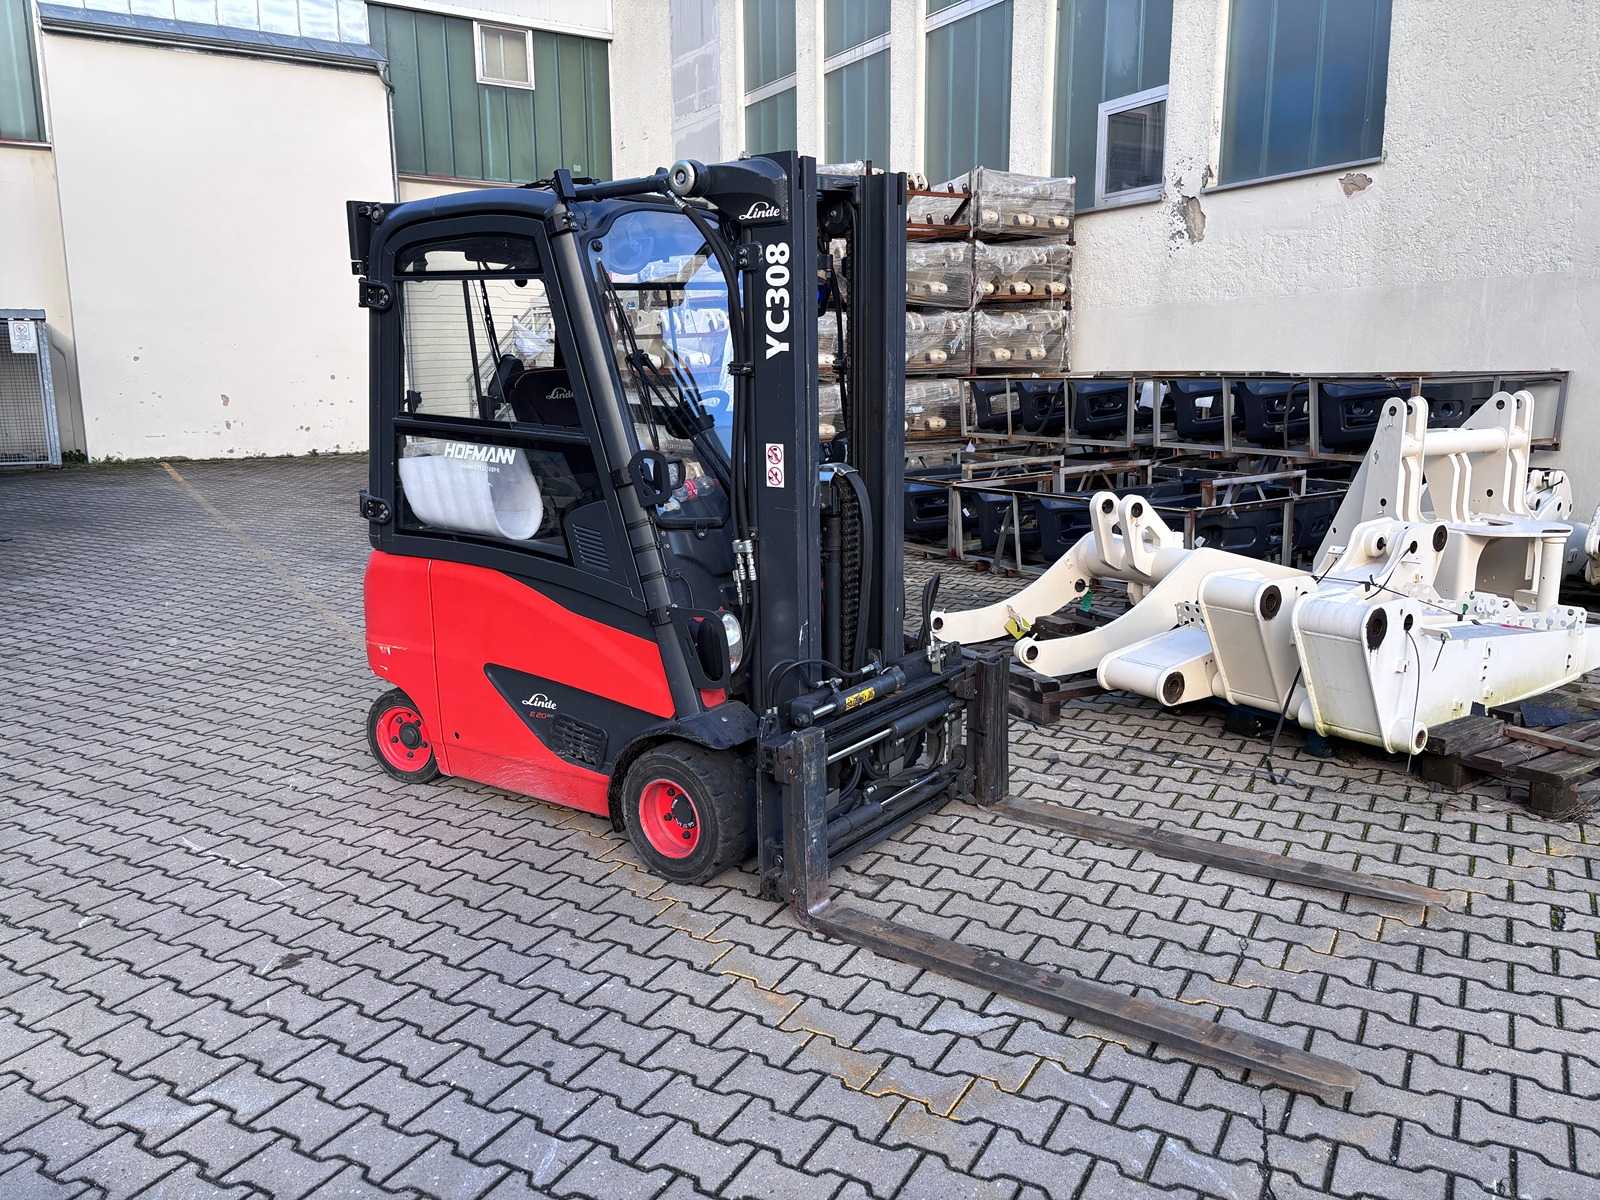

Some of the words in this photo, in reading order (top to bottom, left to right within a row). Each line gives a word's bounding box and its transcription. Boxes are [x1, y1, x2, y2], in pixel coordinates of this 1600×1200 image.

[738, 201, 781, 220] Linde
[765, 242, 790, 360] YC308
[444, 442, 517, 465] HOFMANN
[521, 693, 557, 710] Linde
